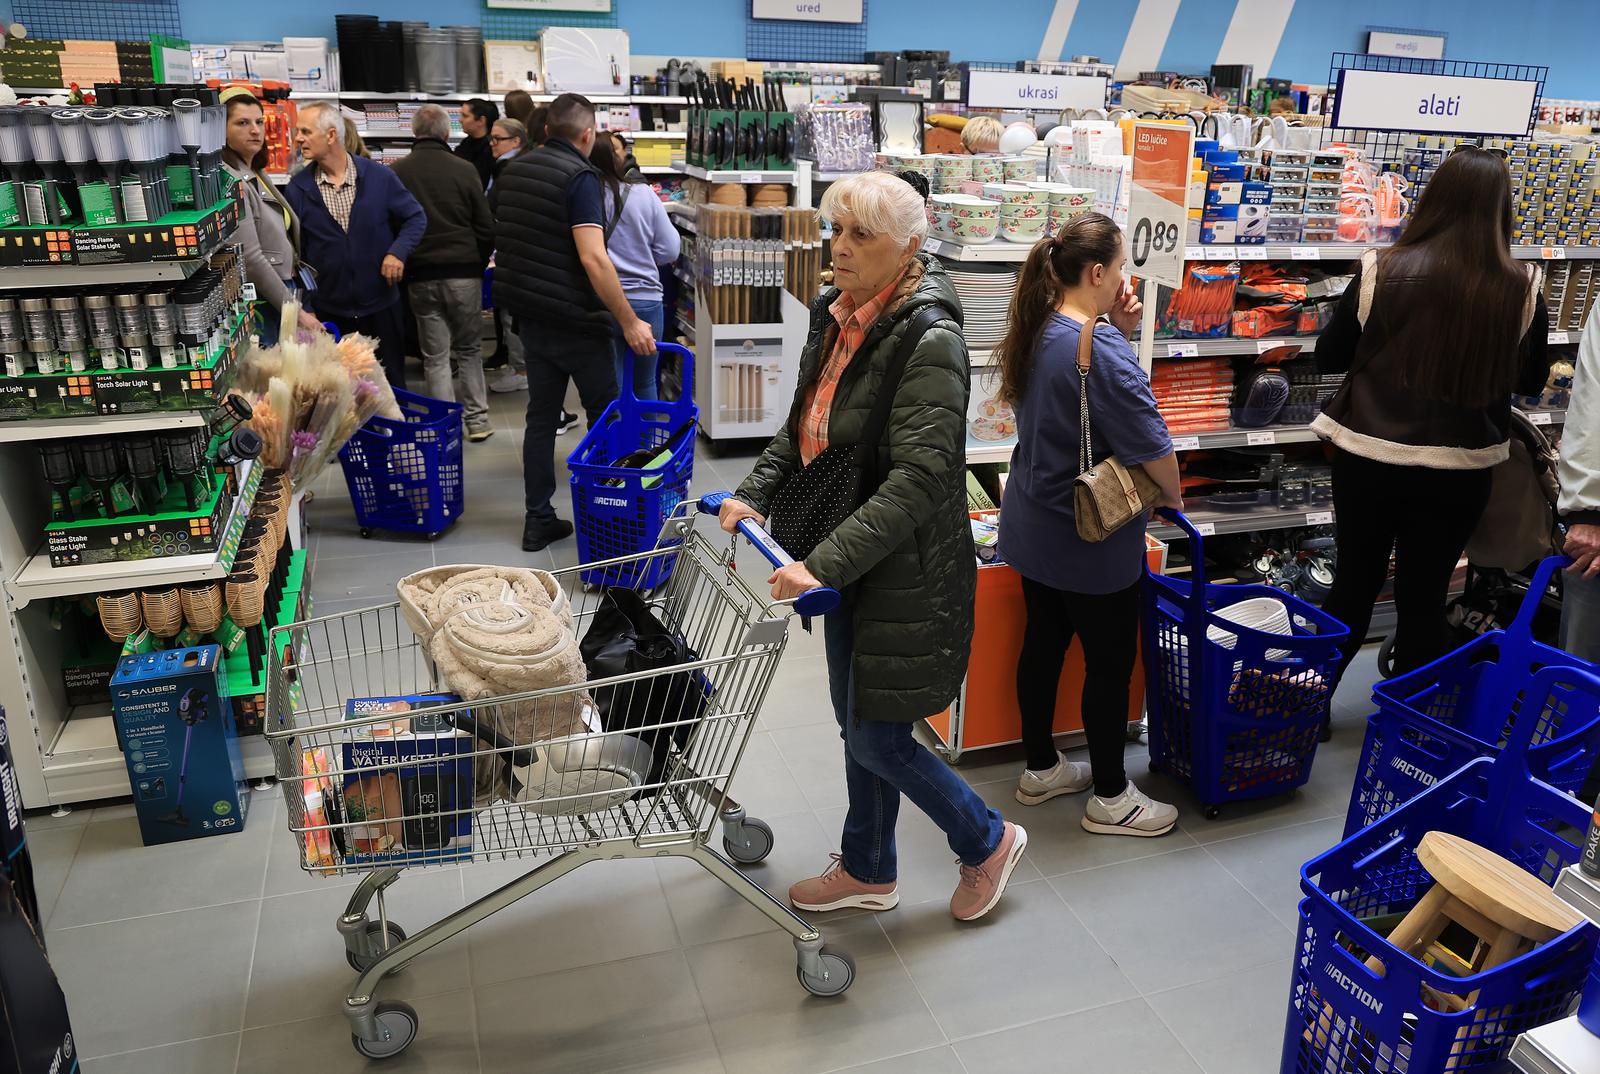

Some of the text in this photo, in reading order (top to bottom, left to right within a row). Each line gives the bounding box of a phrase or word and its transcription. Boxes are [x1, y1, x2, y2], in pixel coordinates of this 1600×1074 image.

[796, 3, 821, 13] ured
[1018, 85, 1059, 99] ukrasi
[1418, 93, 1461, 116] alati
[1138, 133, 1168, 145] LED lučice
[6, 385, 24, 393] Light
[115, 380, 131, 388] Solar
[132, 380, 148, 388] Light
[598, 497, 627, 507] ACTION
[48, 535, 88, 545] Glass Stake
[68, 543, 87, 551] Light
[65, 673, 90, 681] Dancing
[131, 685, 177, 697] SAUBER
[120, 703, 160, 712] CONSISTENT
[122, 706, 170, 719] DESIGN AND
[124, 715, 157, 724] QUALITY
[352, 747, 383, 759] Digital
[352, 755, 397, 766] WATER
[0, 762, 18, 830] DRAUGHT
[1331, 968, 1384, 1015] ACTION
